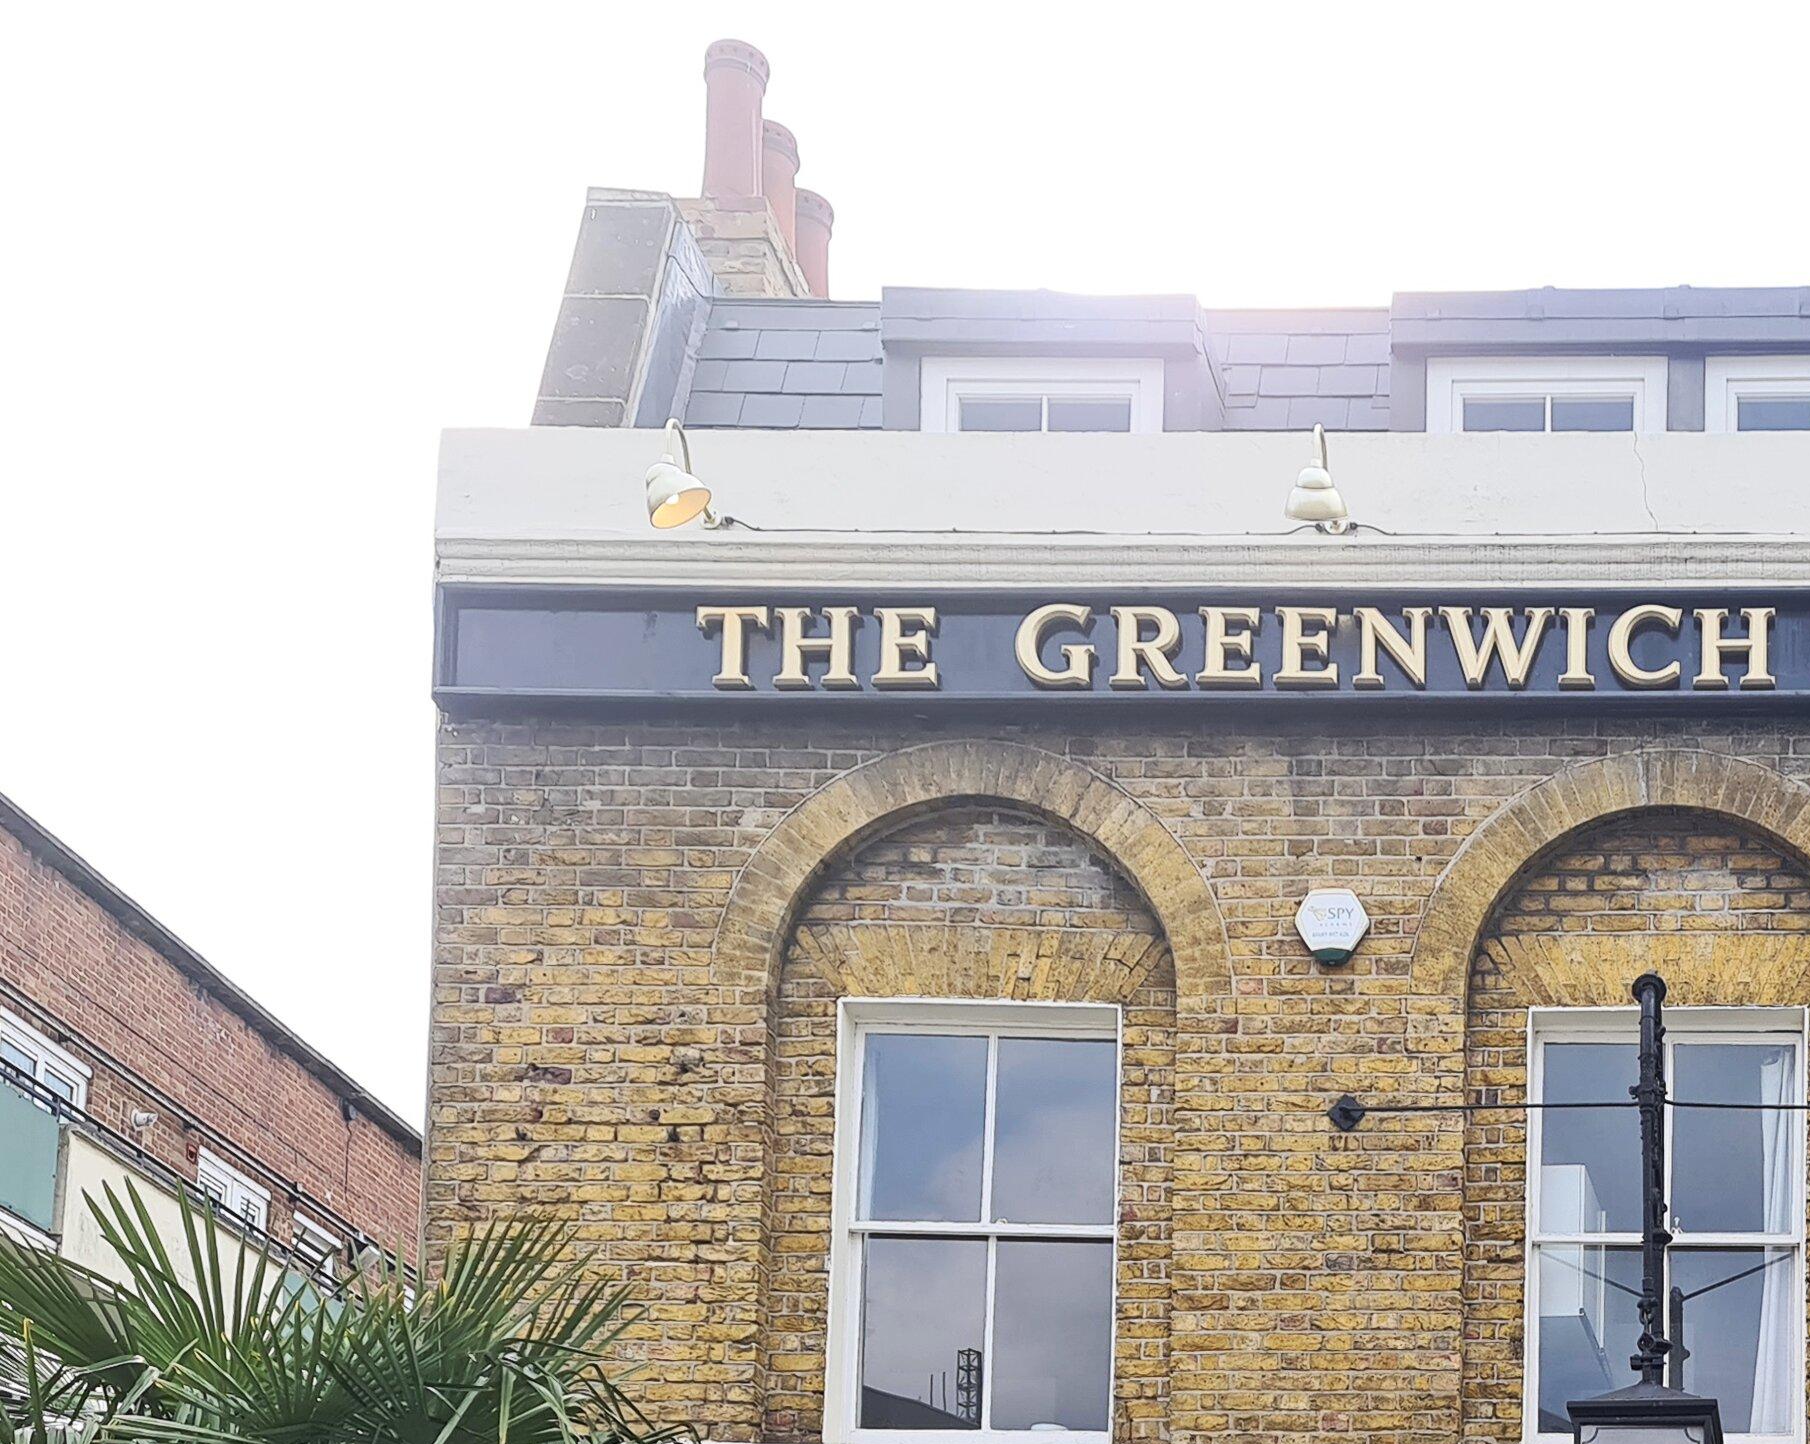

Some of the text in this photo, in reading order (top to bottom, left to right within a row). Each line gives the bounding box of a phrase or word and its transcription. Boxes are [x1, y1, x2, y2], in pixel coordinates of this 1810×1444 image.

[696, 606, 939, 689] THE
[1014, 603, 1776, 690] GREENWICH
[1327, 907, 1354, 919] SPY
